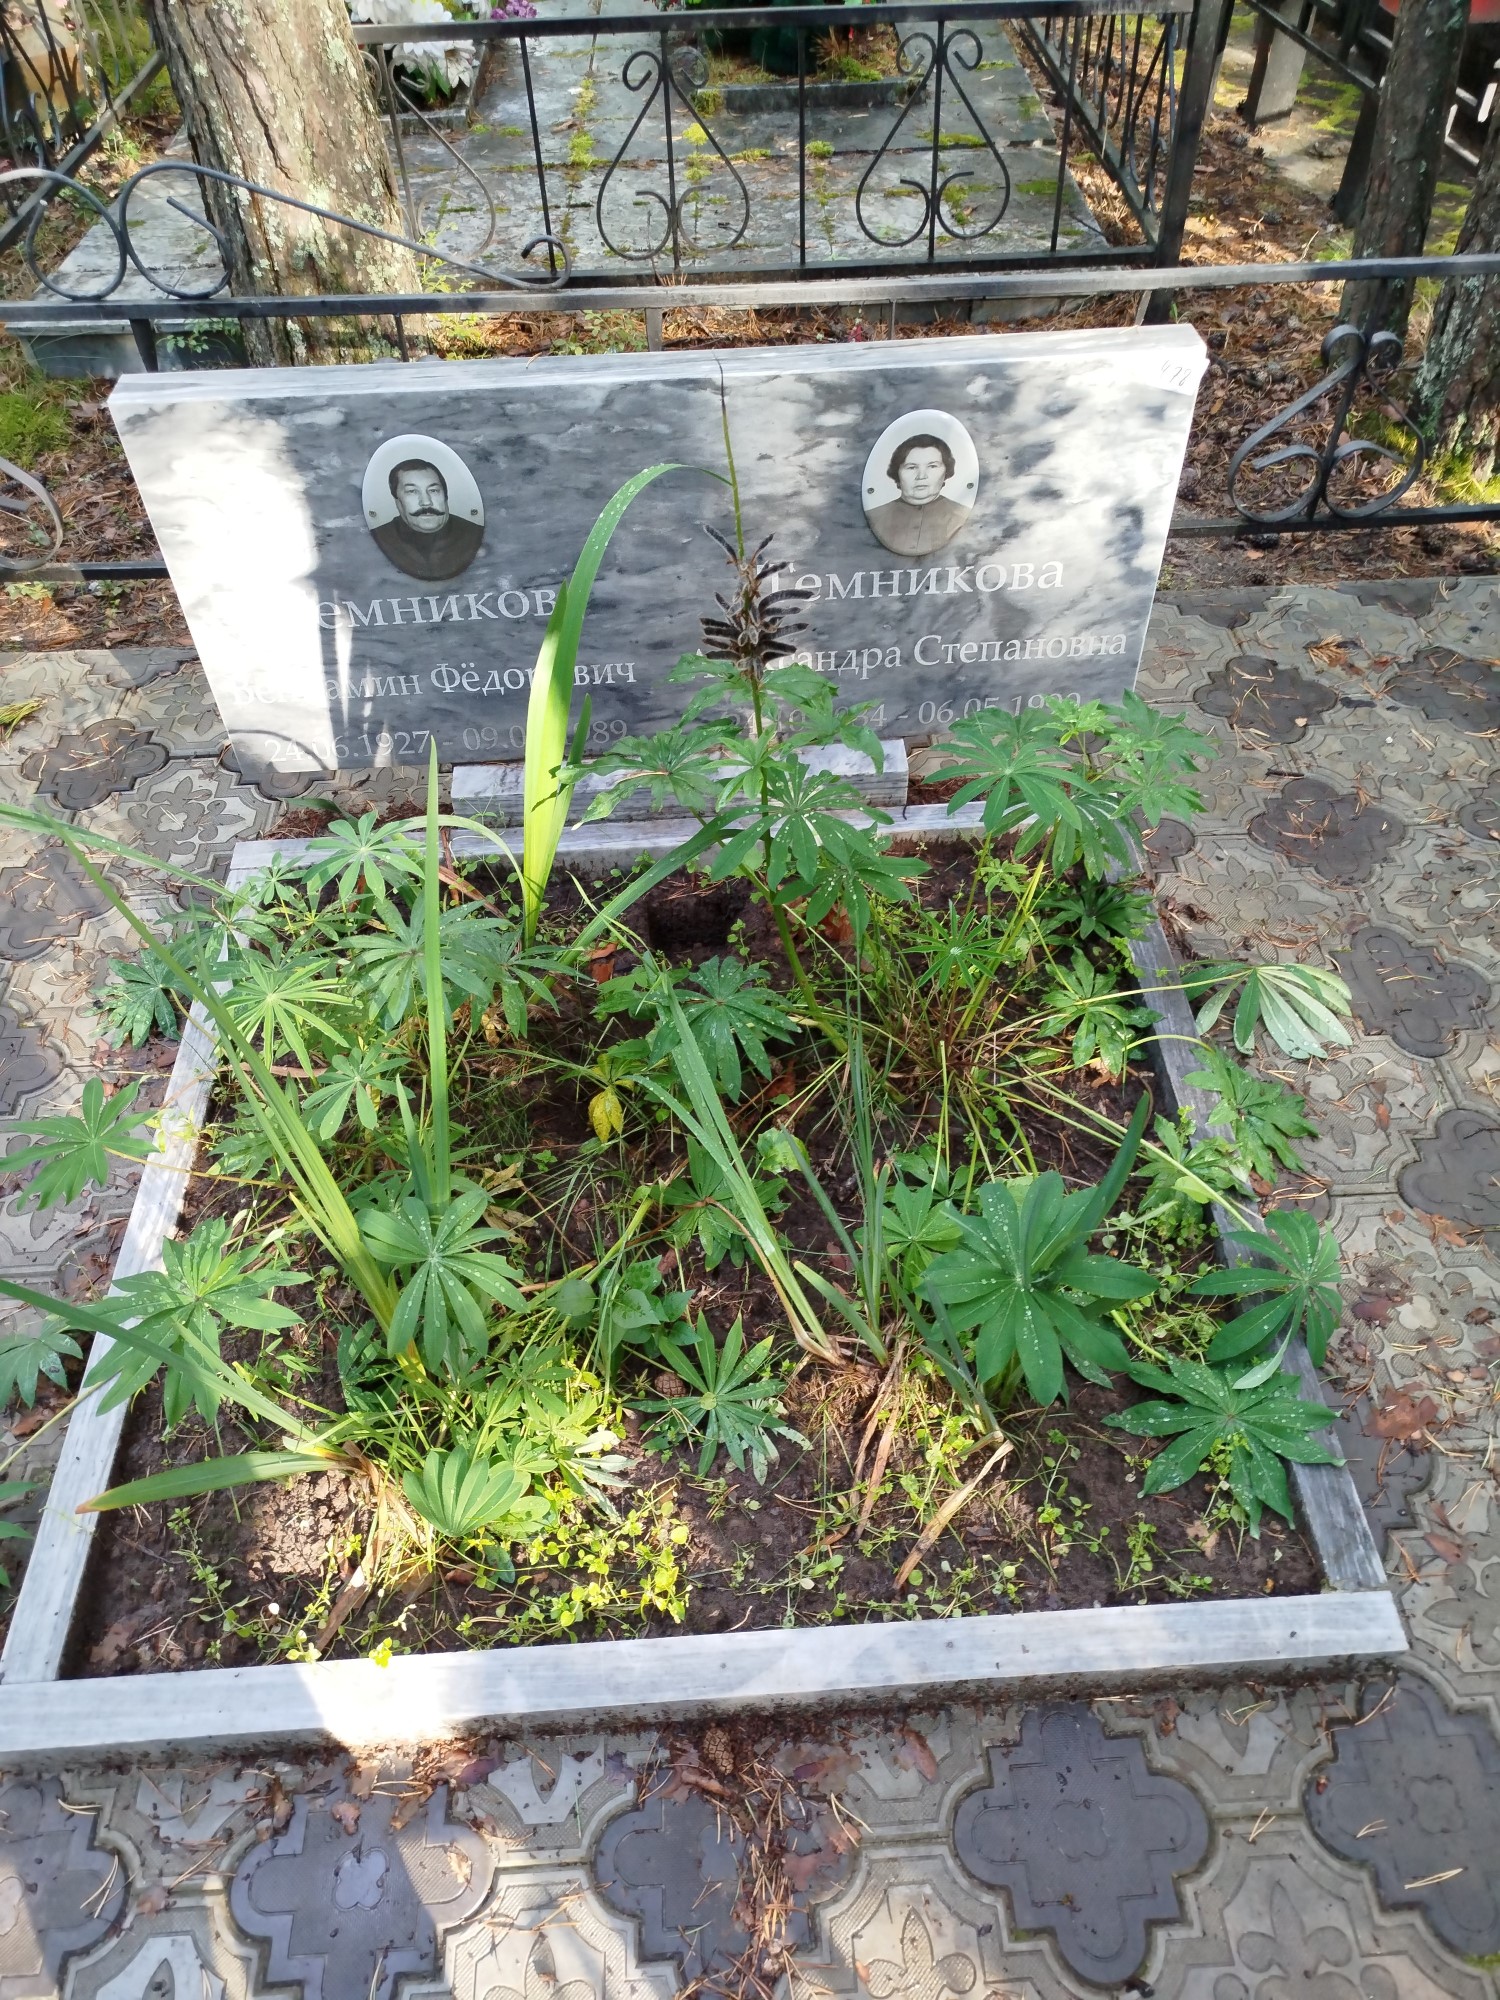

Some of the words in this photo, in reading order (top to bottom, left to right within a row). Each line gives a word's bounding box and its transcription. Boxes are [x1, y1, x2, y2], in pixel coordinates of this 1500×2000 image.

[317, 588, 557, 630] емников
[914, 633, 1128, 667] Степановна
[430, 662, 638, 697] Фёдович
[264, 729, 431, 763] 24.06.1927
